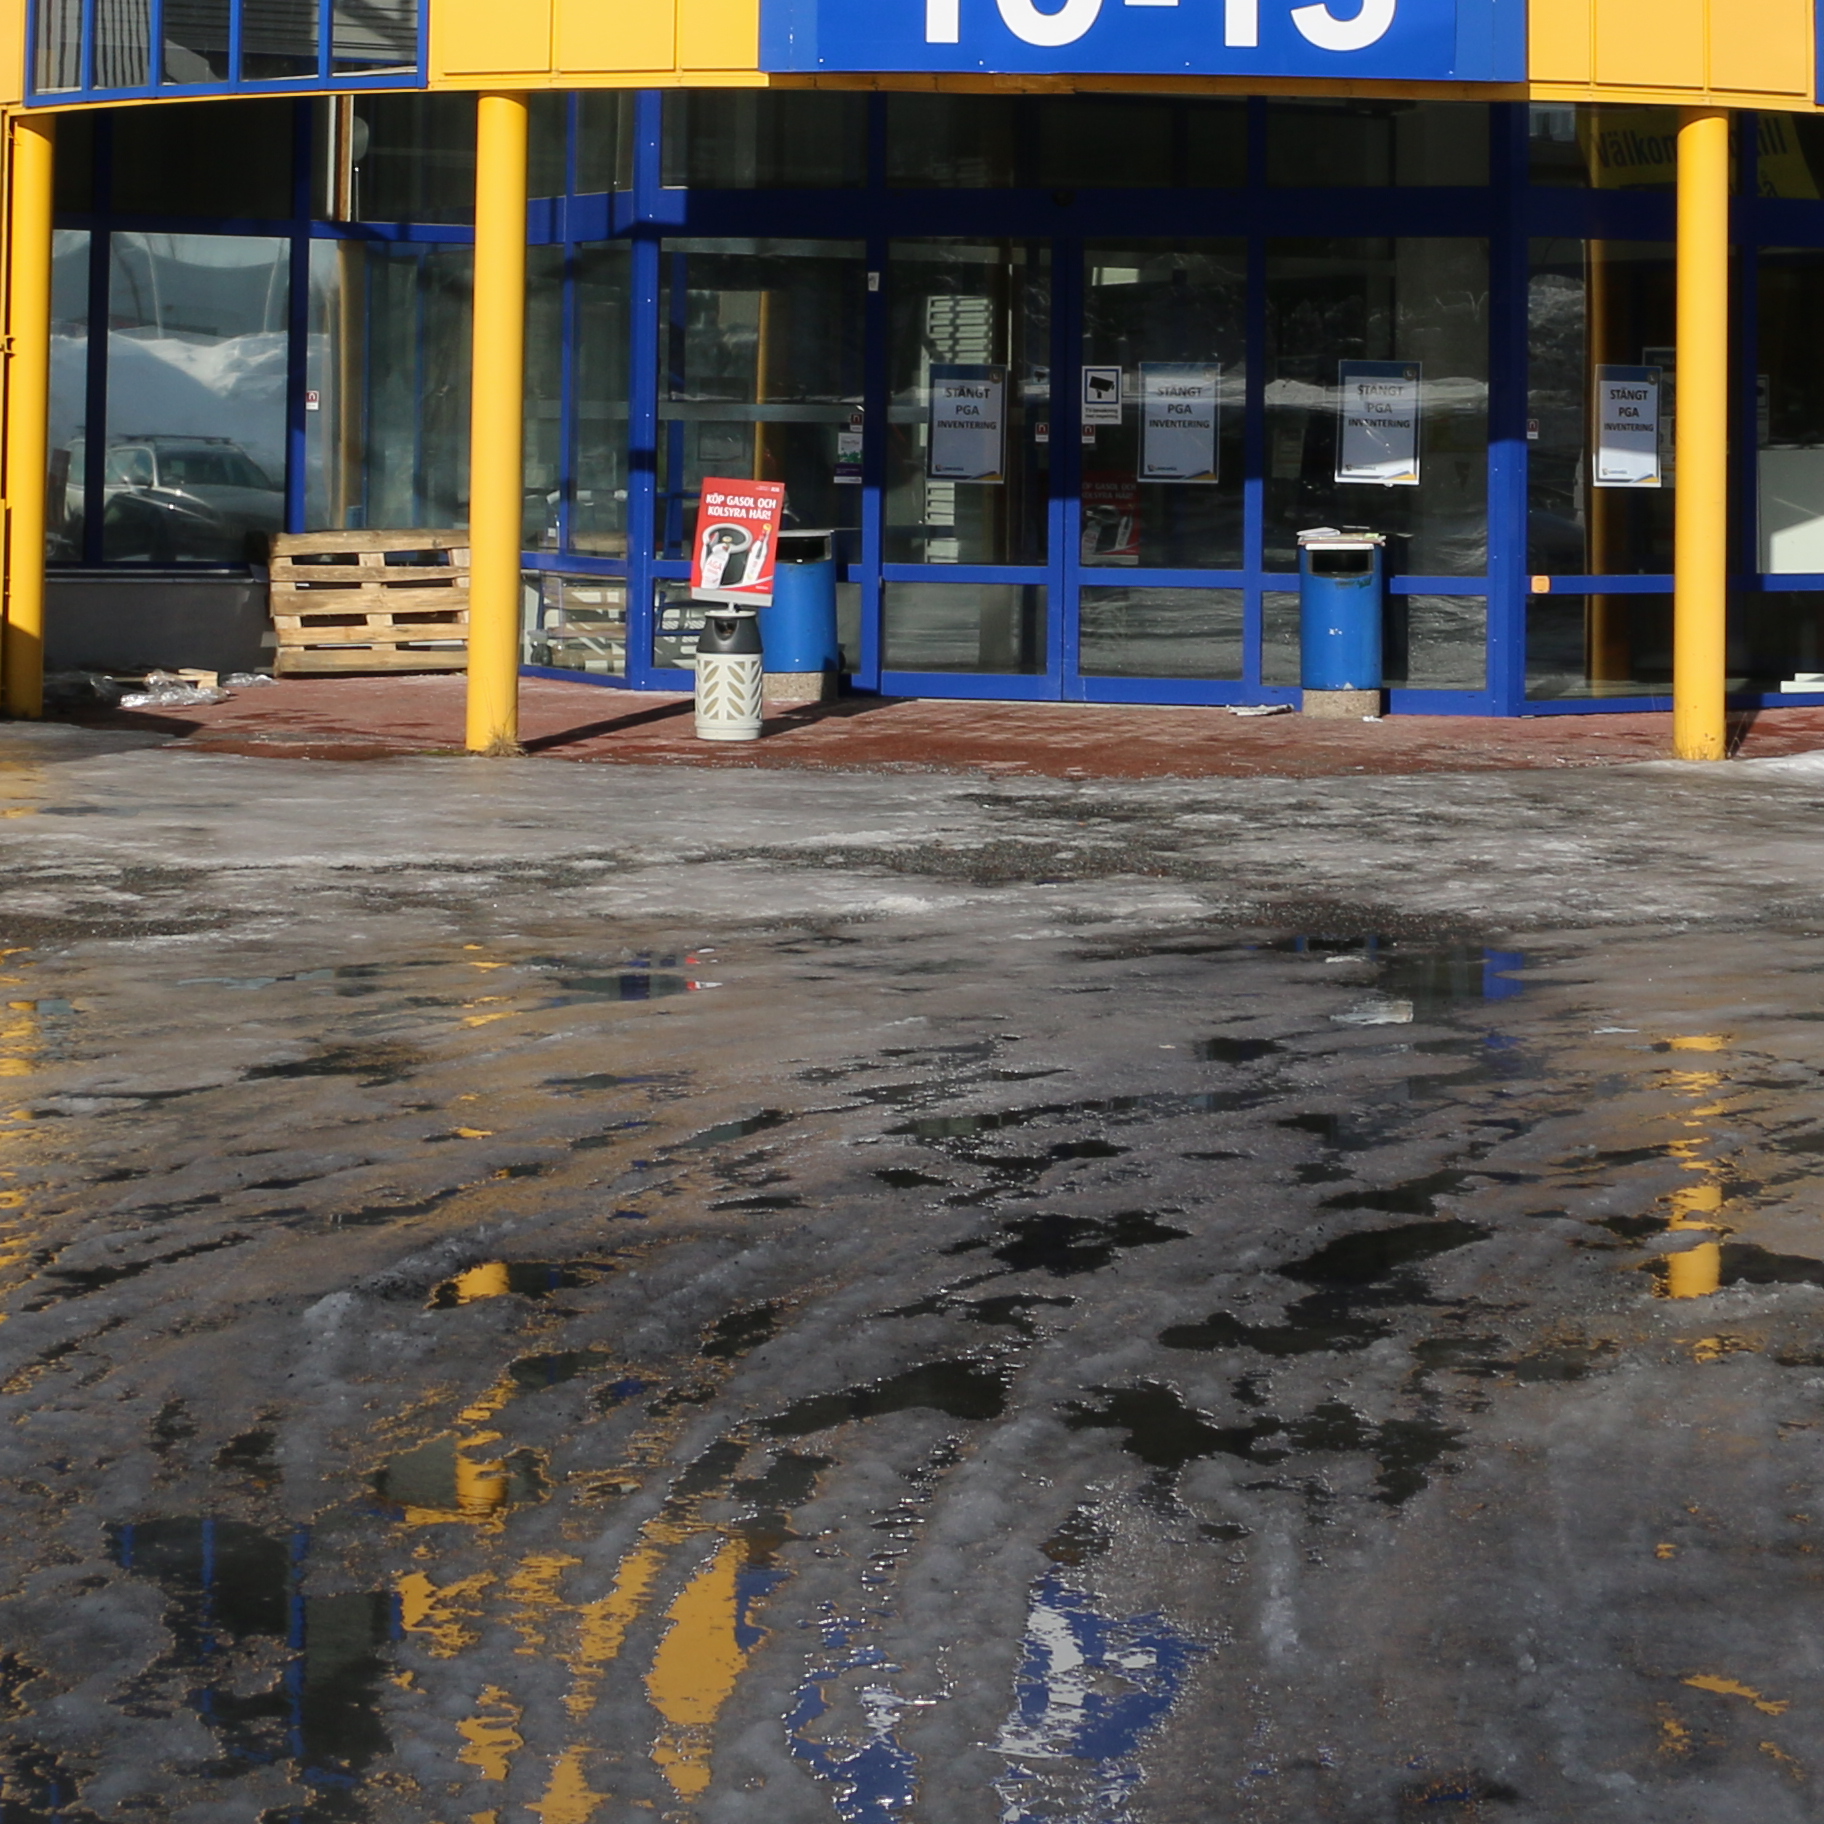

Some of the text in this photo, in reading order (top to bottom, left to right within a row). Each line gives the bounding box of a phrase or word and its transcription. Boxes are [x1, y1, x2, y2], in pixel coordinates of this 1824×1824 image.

[945, 385, 991, 398] STÄNGT
[1610, 387, 1648, 401] STÄNGT
[956, 405, 980, 416] PGA
[1167, 404, 1193, 415] PGA
[1367, 402, 1393, 414] PGA
[1618, 407, 1640, 417] PGA
[937, 420, 997, 430] INVENTERING
[1149, 419, 1210, 429] INVENTERING
[1348, 418, 1411, 429] INVENTERING
[1603, 423, 1655, 432] INVENTERING
[706, 492, 776, 509] KÖP GASOL OCH
[707, 505, 772, 520] KOLSYRA HÄR!
